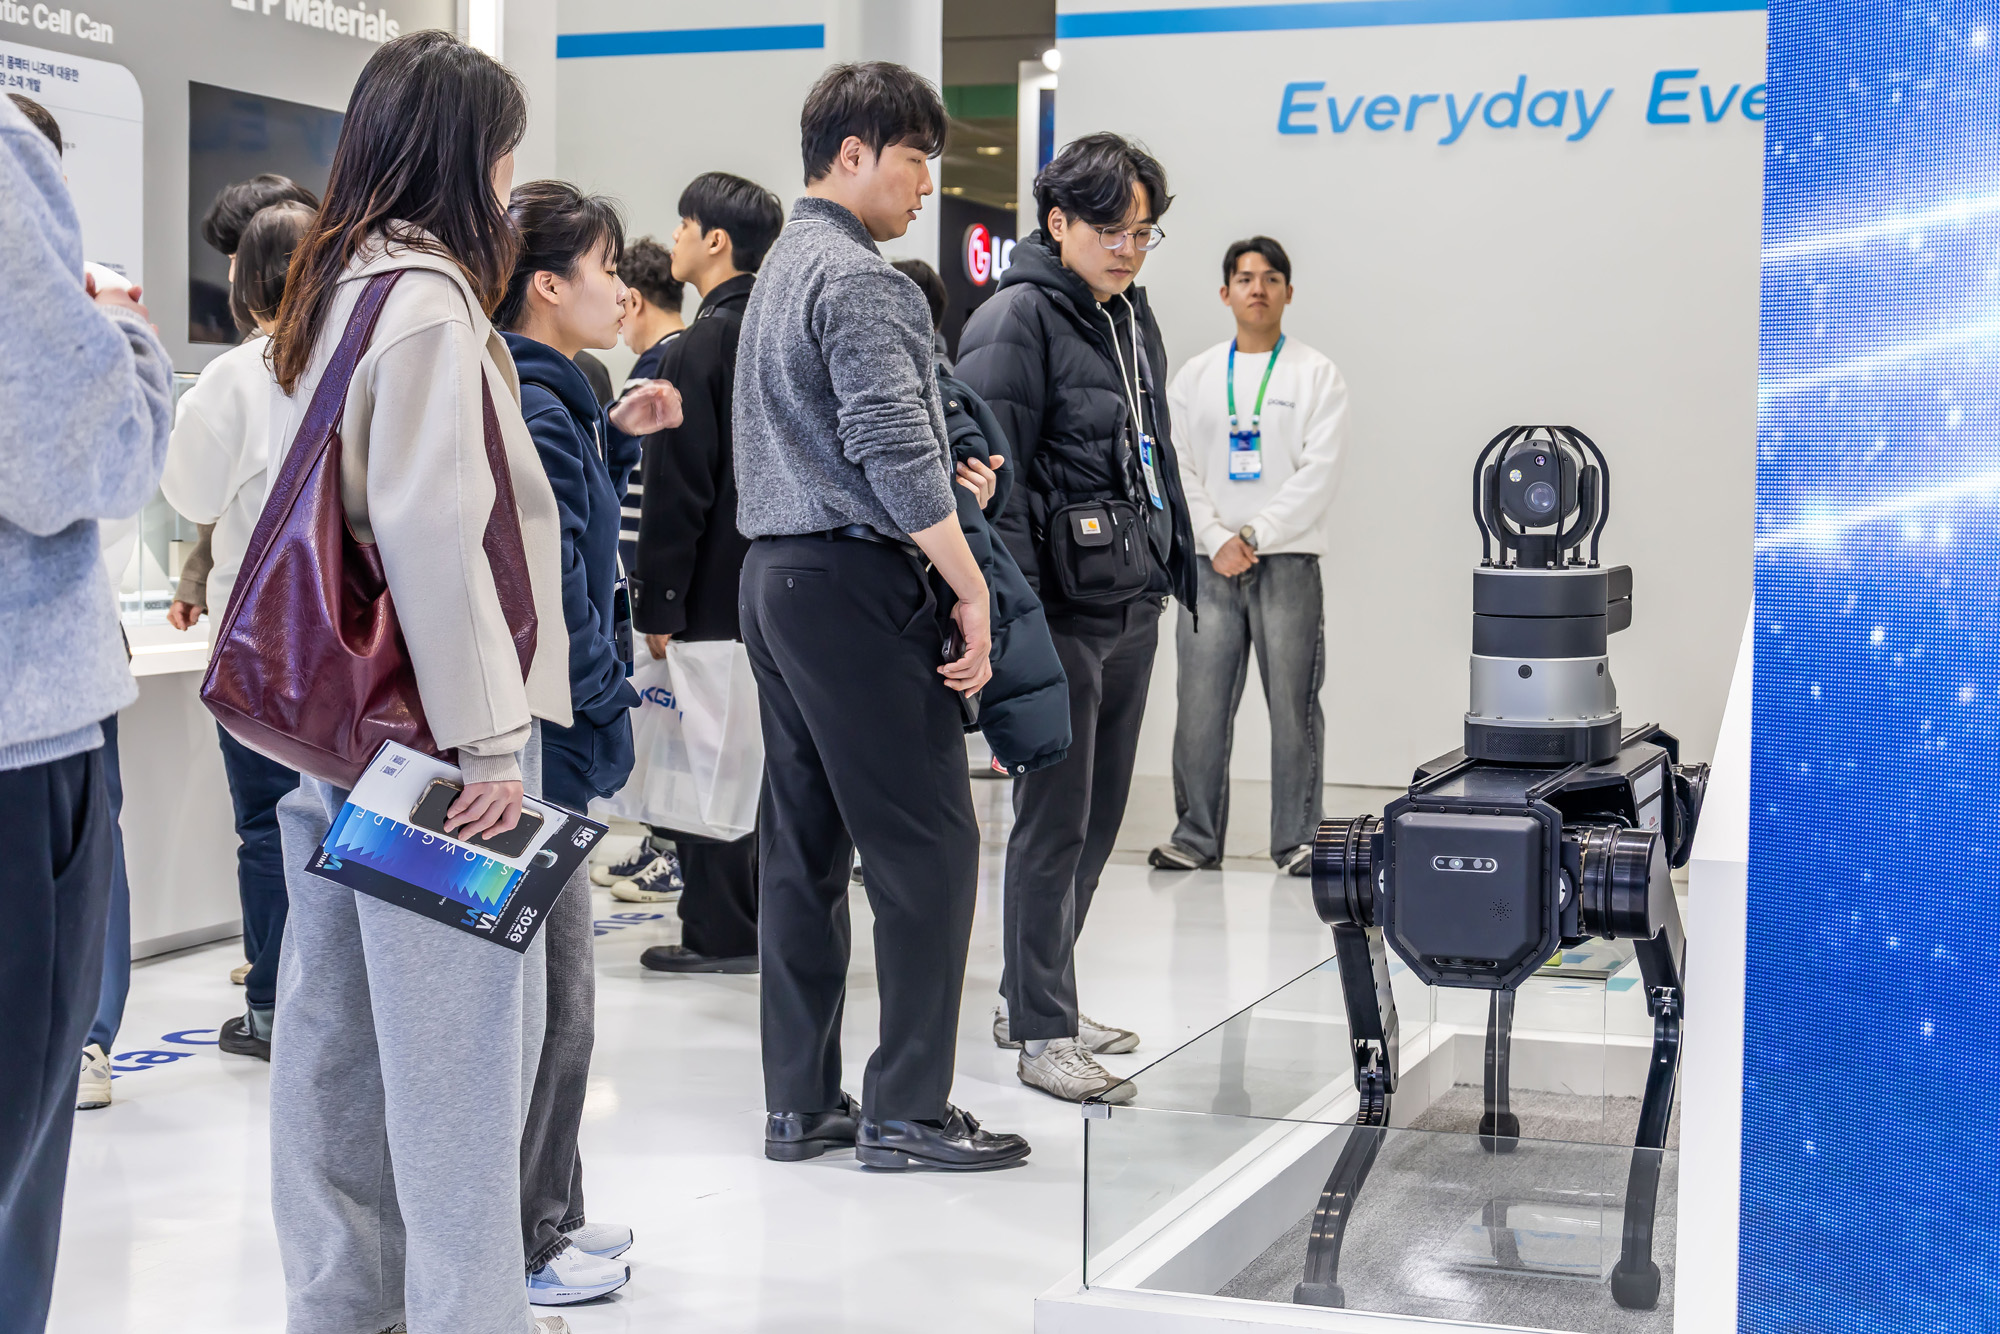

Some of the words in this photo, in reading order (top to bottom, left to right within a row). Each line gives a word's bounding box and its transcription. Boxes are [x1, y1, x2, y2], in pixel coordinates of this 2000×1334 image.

[0, 0, 30, 25] tic
[32, 3, 72, 35] Cell
[74, 12, 113, 44] Can
[285, 0, 400, 44] Materials
[1277, 74, 1615, 146] Everyday
[510, 906, 538, 943] 2026
